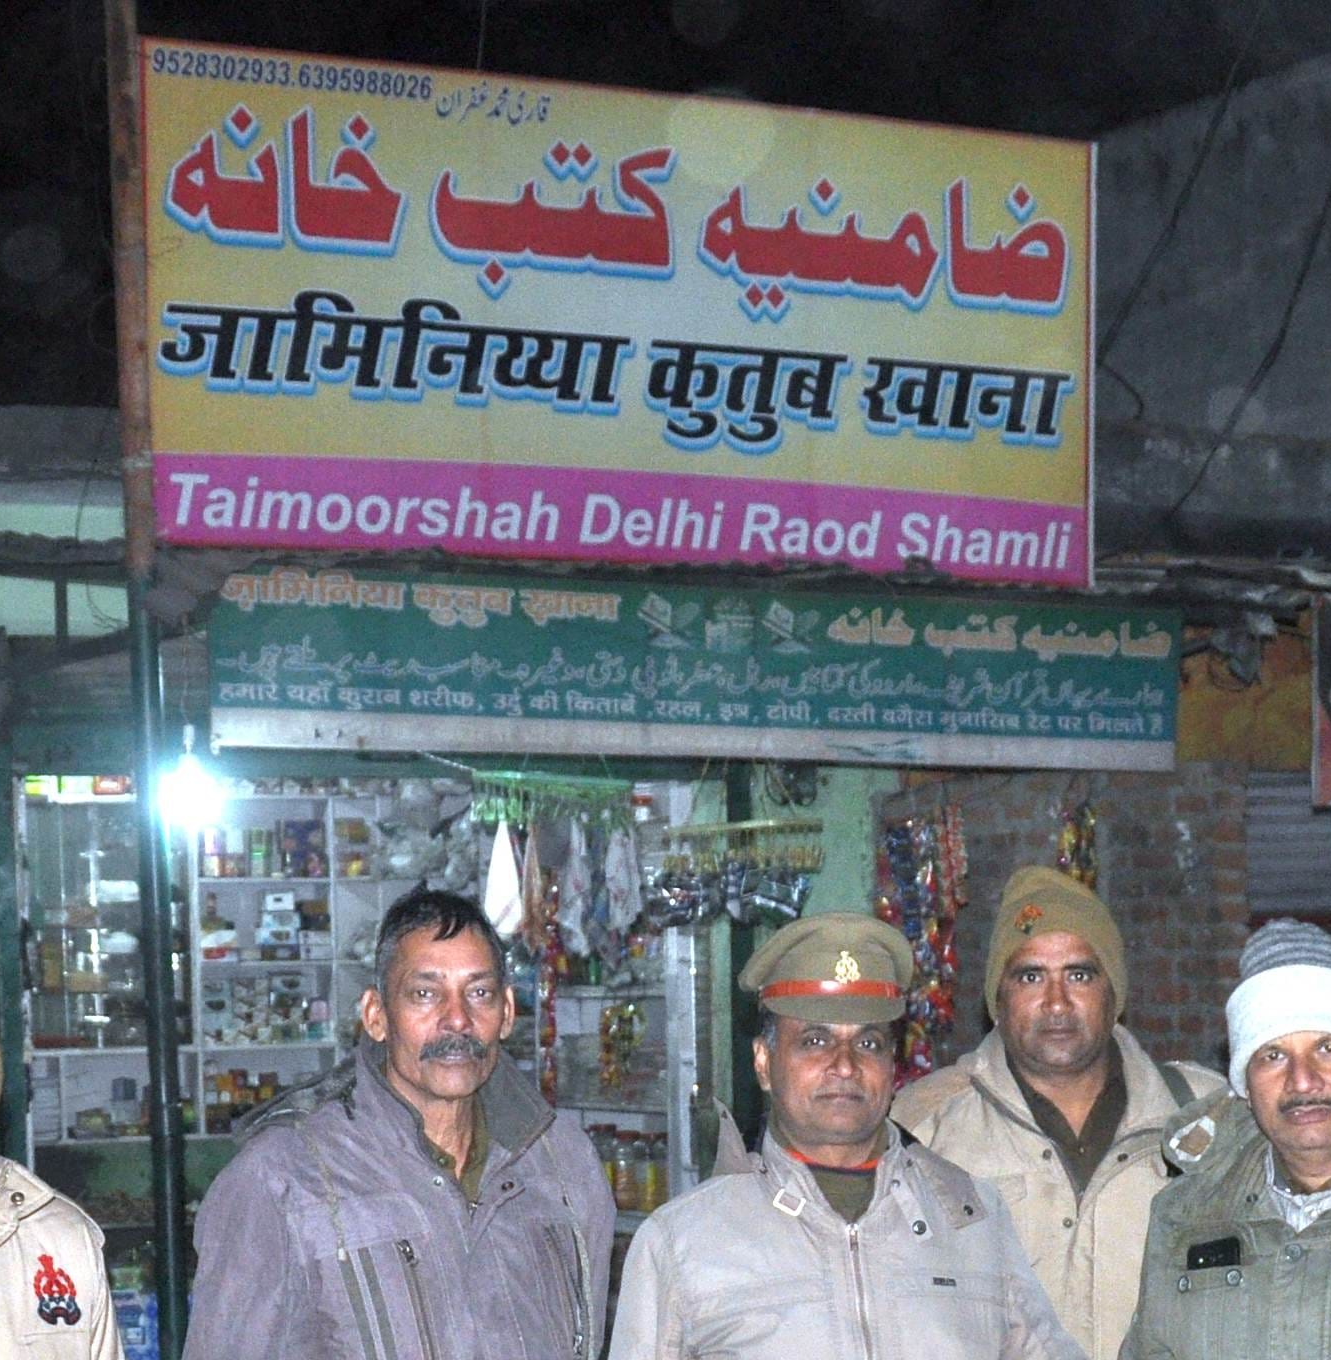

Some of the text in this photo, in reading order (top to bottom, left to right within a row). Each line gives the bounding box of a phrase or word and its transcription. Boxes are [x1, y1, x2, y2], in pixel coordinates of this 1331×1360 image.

[153, 49, 432, 100] 9528302933.6395988026
[166, 102, 407, 254] خانہ
[433, 141, 673, 298] کتب
[646, 336, 847, 457] कुतुब
[861, 356, 1075, 454] खाना
[169, 473, 1072, 570] Taimoorshah Delhi Raod Shamli
[528, 689, 559, 711] की
